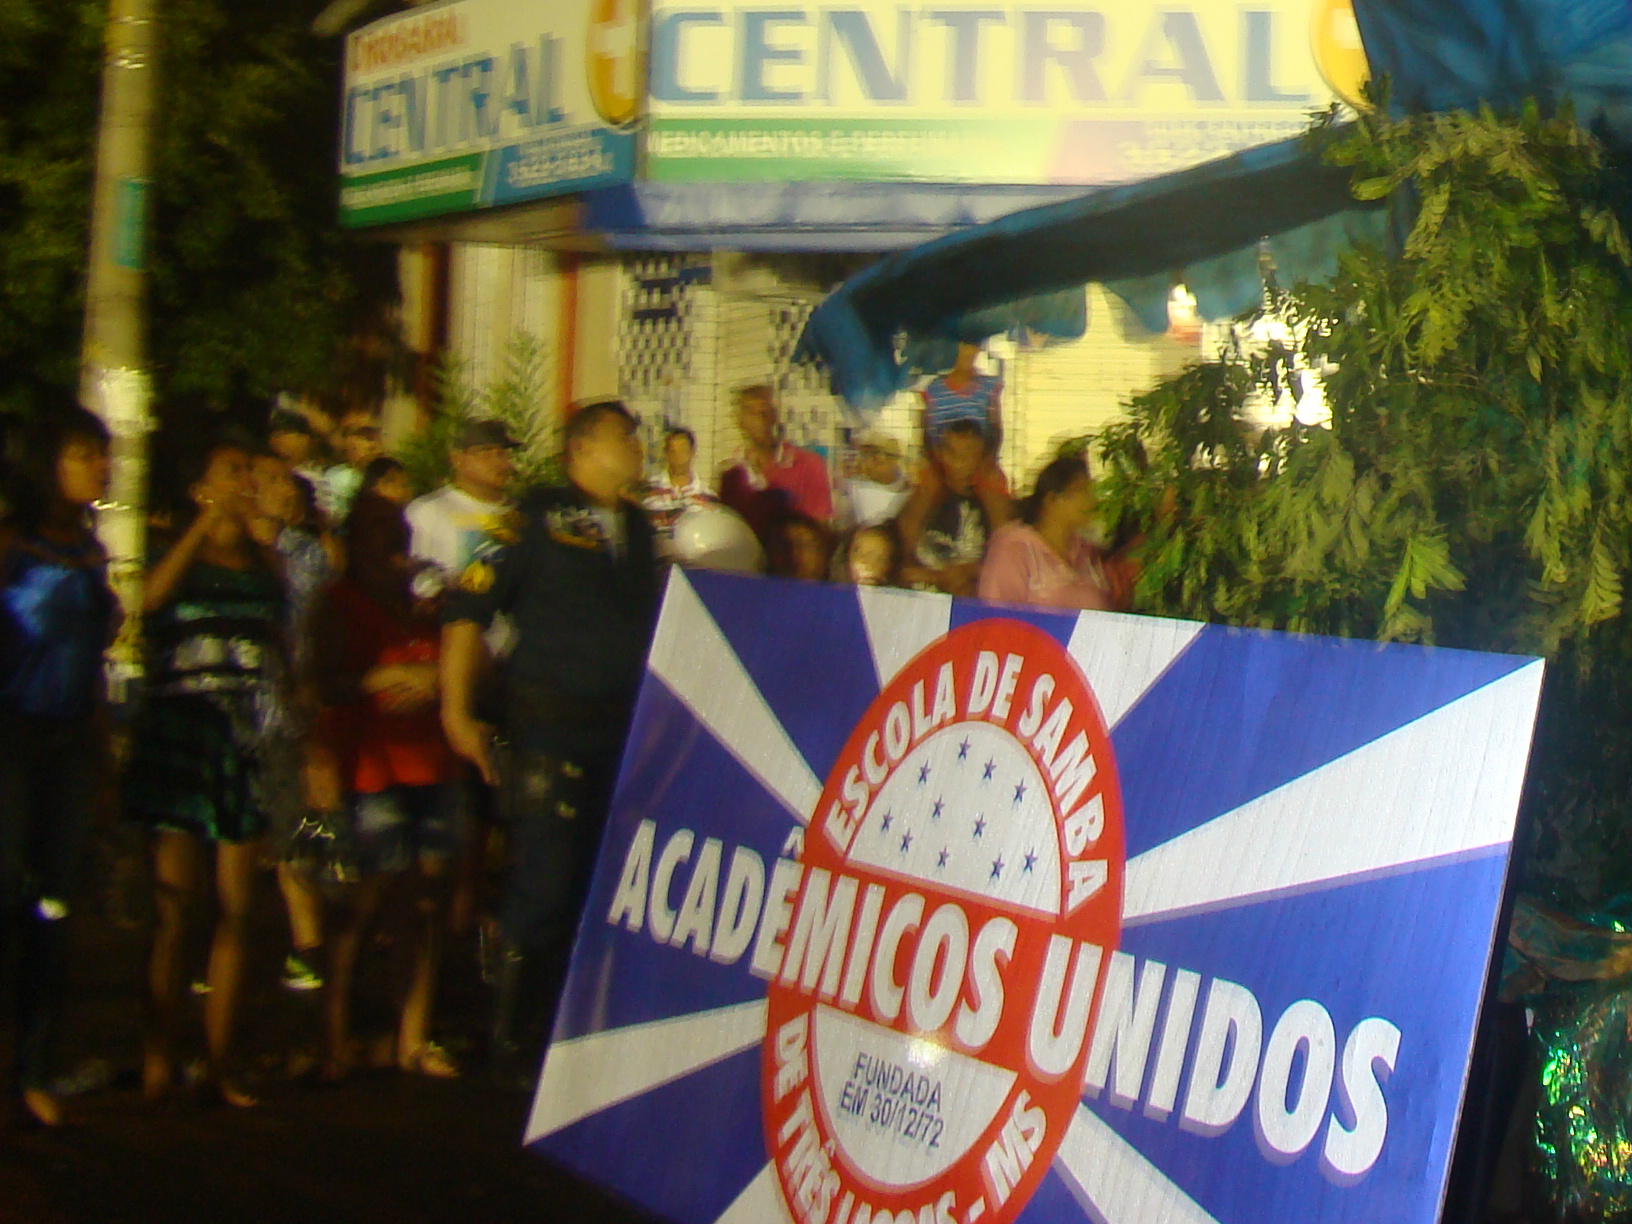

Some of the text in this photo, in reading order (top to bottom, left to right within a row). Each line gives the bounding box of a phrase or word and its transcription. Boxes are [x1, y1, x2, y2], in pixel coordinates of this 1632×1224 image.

[345, 32, 570, 166] CENTRAL
[650, 5, 1315, 106] CENTRAL
[826, 650, 1108, 912] ESCOLA DE SAMBA
[608, 820, 1402, 1176] ACADÊMICOS UNIDOS
[839, 1081, 944, 1149] EM 30/12/72
[852, 1051, 943, 1114] FUNDADA
[985, 1089, 1047, 1206] MS
